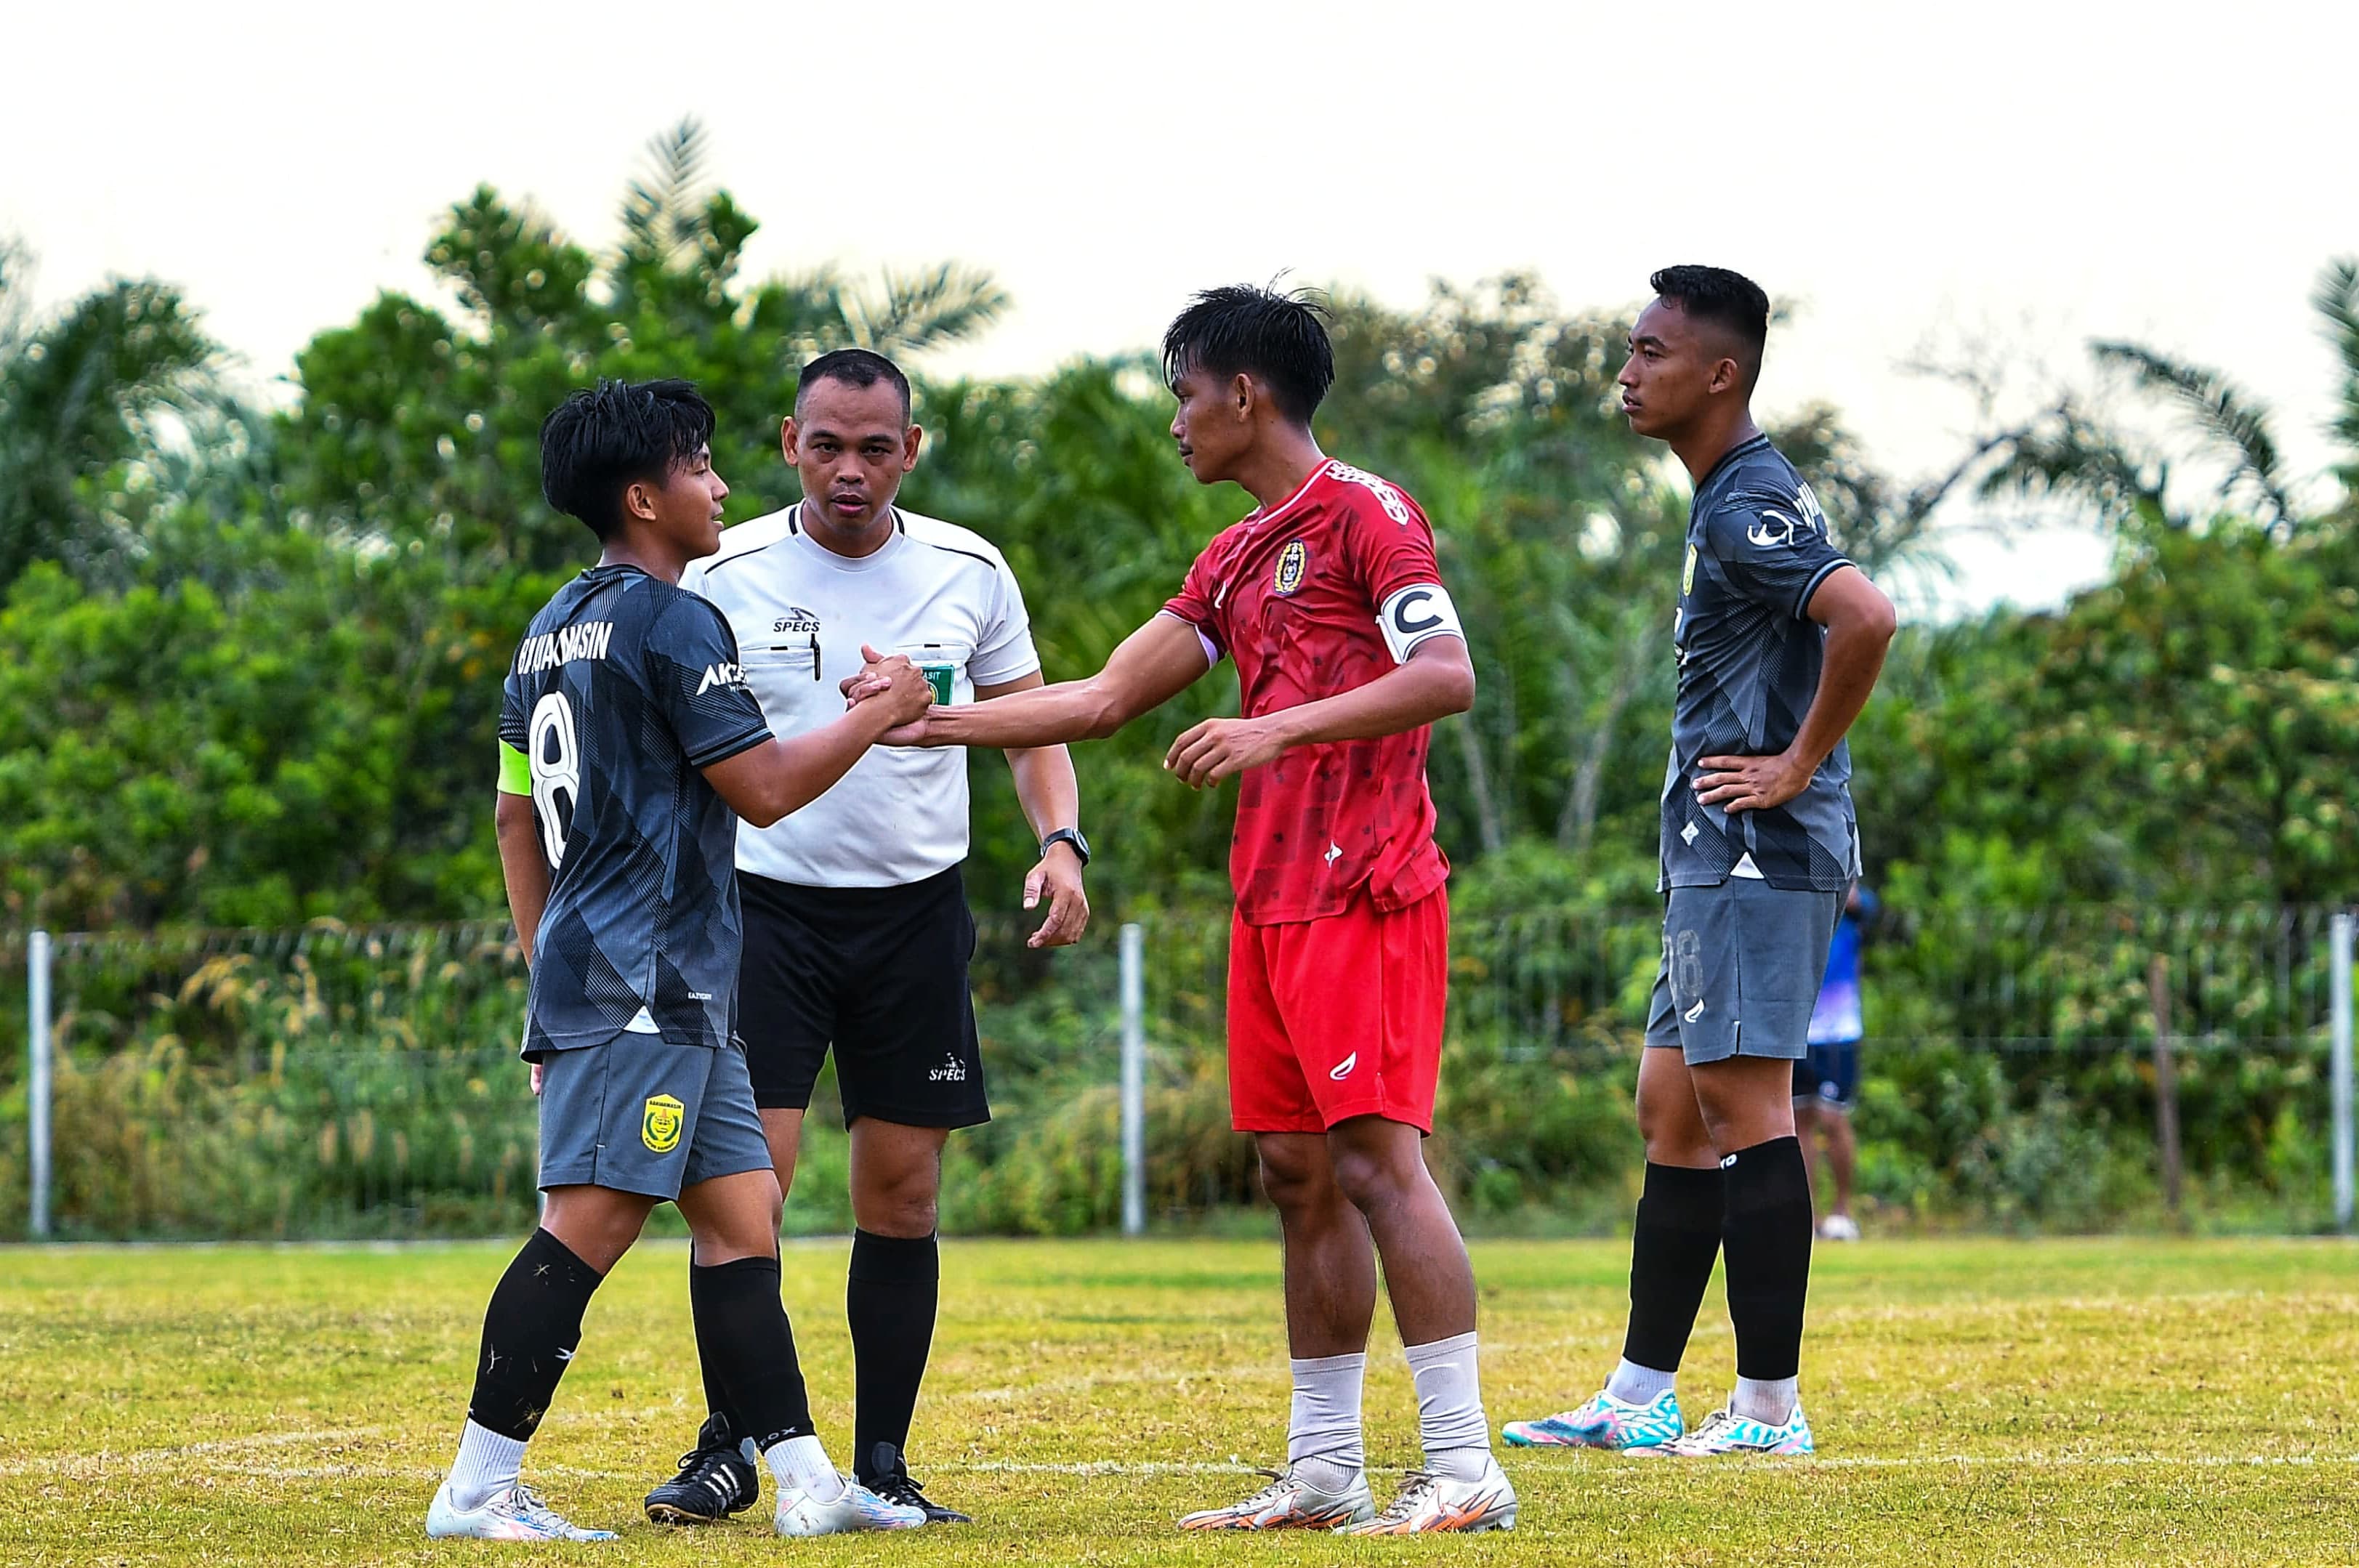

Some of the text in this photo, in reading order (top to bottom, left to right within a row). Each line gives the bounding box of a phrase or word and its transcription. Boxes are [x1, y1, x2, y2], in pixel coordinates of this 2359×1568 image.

[1395, 591, 1443, 634] C
[773, 621, 820, 633] SPECS
[923, 671, 940, 681] ASIT
[529, 690, 579, 870] 8
[929, 1068, 966, 1080] SPECS
